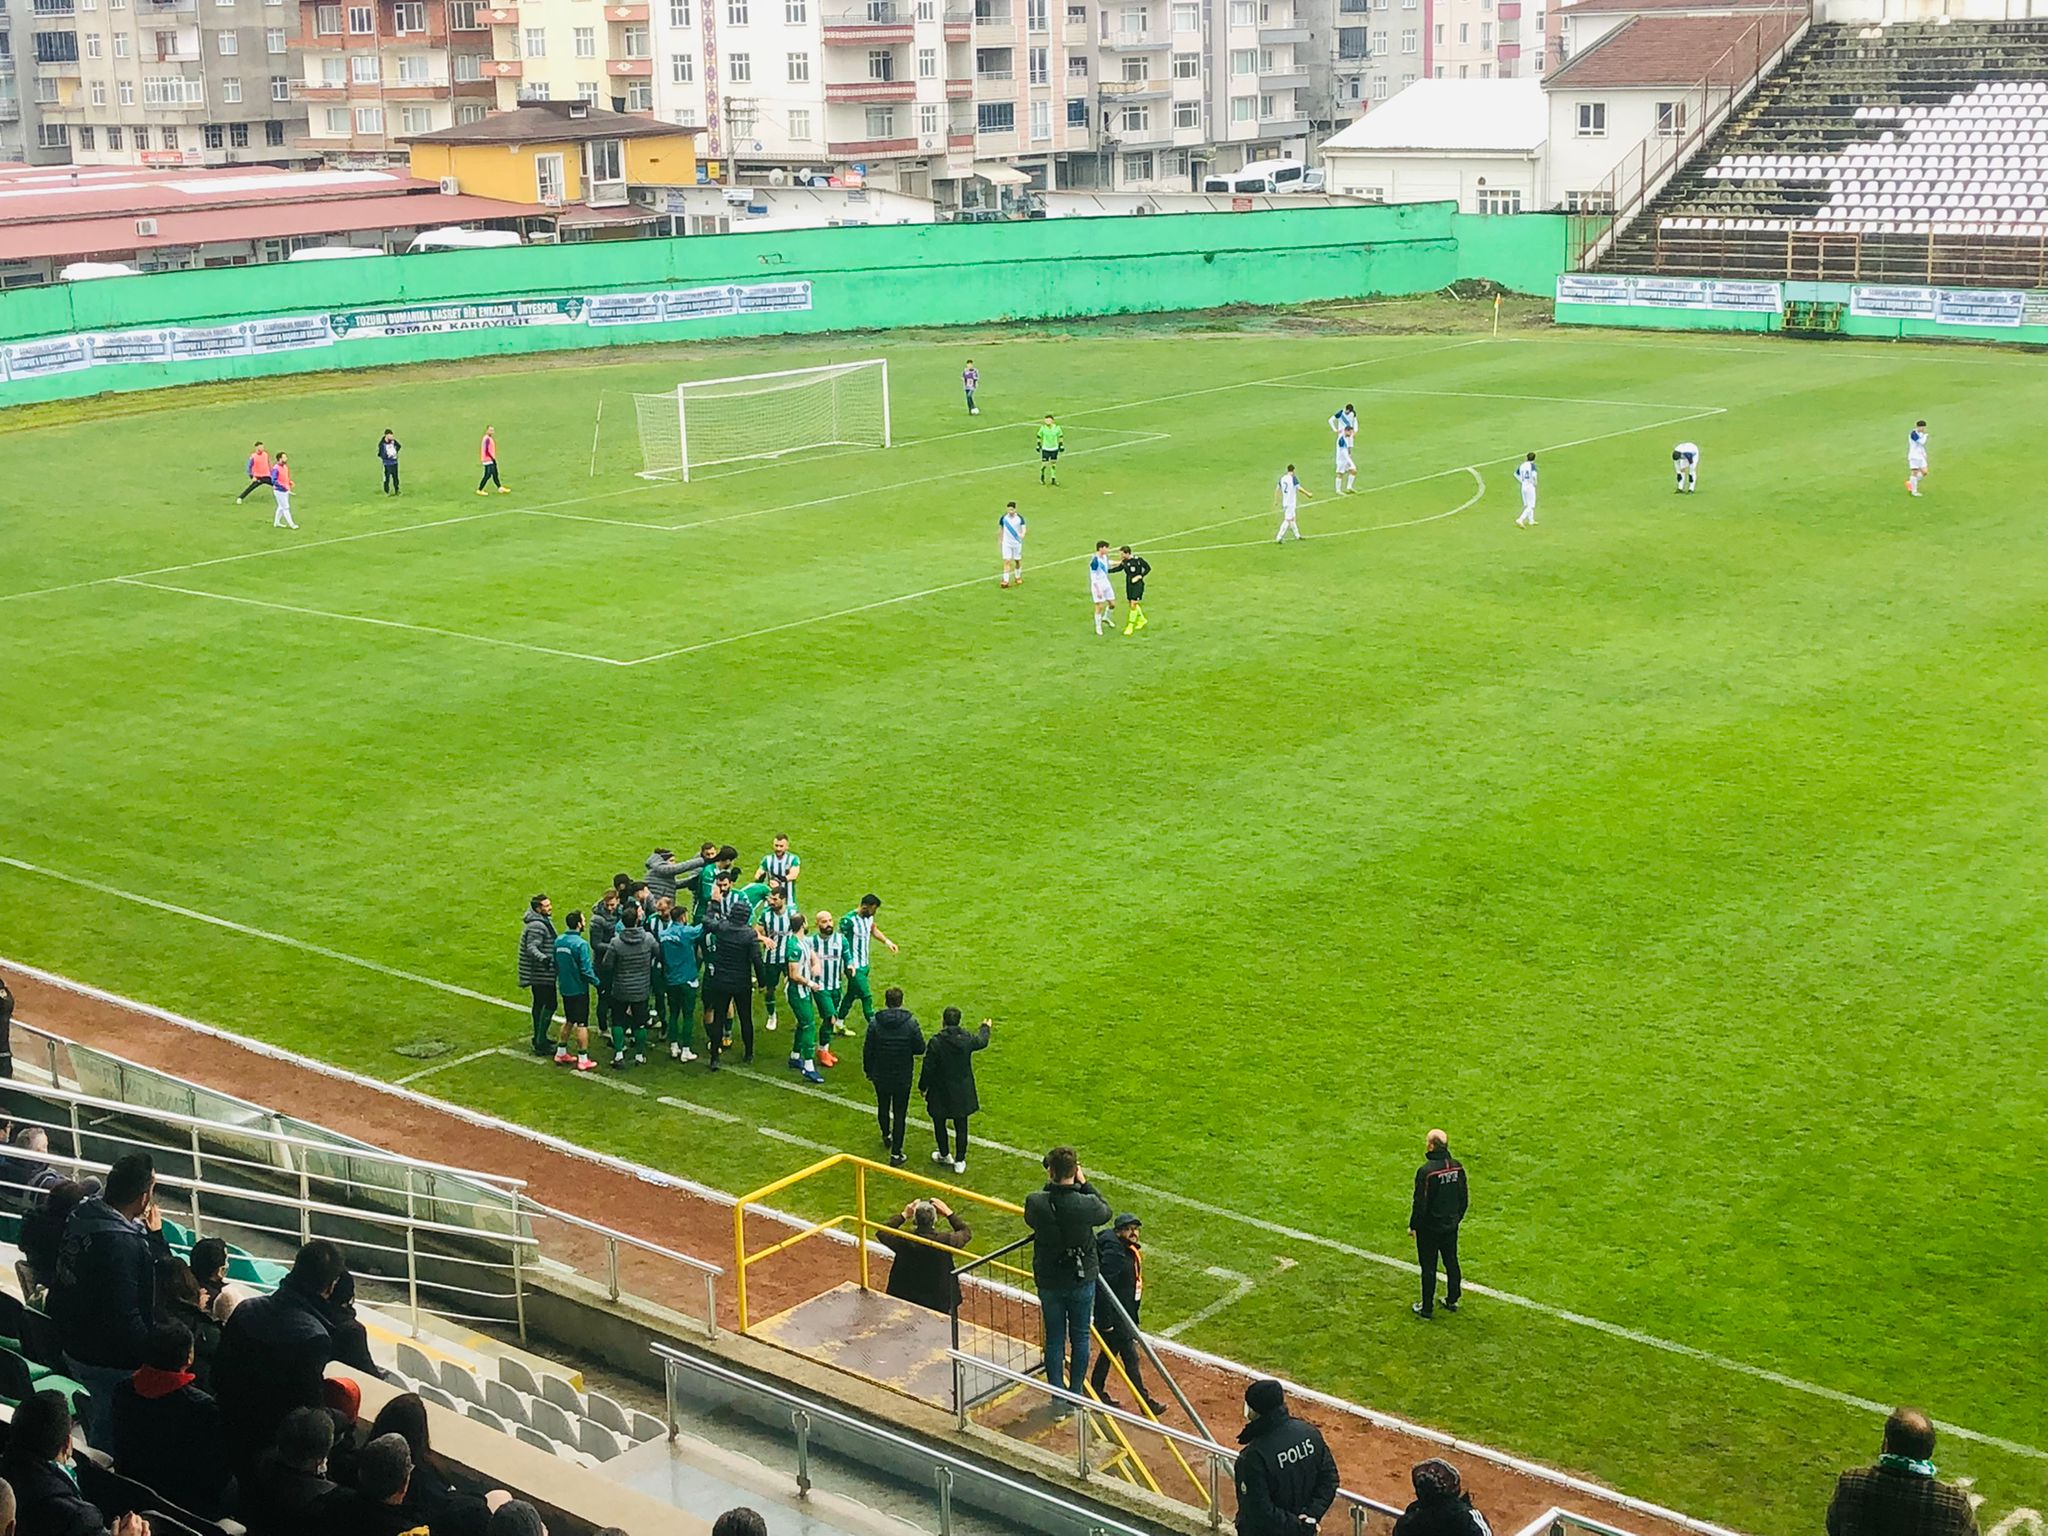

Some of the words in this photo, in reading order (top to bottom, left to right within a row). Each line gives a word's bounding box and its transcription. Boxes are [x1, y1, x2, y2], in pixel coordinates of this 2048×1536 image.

[431, 307, 462, 321] HASRET
[463, 305, 477, 319] BİR
[517, 302, 558, 315] ÜNYESPOR
[384, 324, 442, 335] OSMAN
